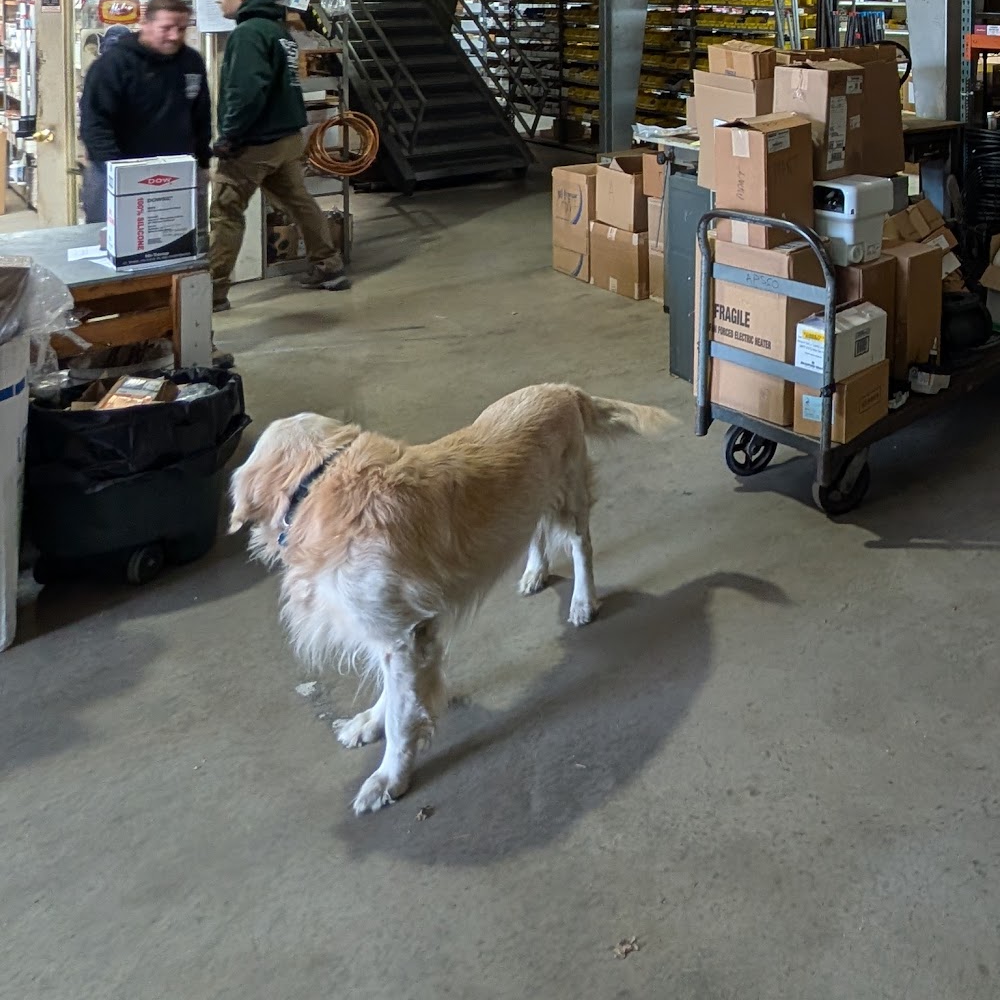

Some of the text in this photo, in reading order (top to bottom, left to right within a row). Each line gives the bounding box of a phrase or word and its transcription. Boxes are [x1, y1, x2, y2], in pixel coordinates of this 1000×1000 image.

[136, 197, 145, 251] 100% SILICONE
[714, 303, 751, 328] FRAGILE
[717, 325, 734, 339] FORCED
[734, 331, 755, 345] ELECTRIC
[754, 337, 772, 350] HEATER
